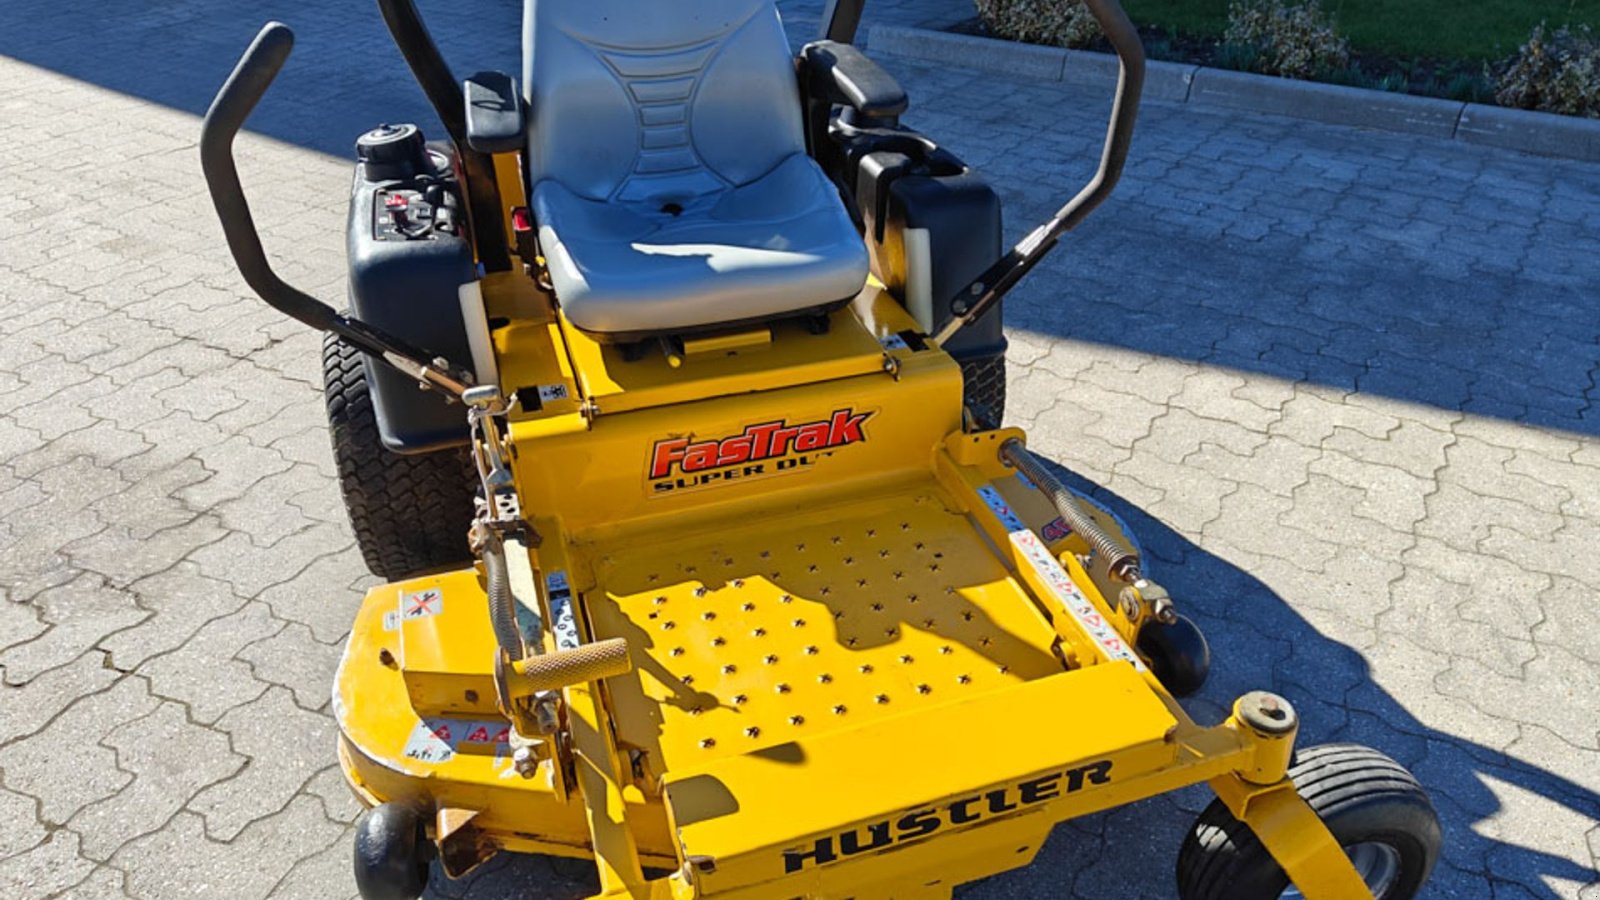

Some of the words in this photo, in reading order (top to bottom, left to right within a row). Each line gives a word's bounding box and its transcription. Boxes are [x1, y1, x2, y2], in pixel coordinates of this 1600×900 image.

[649, 408, 876, 480] FasTrak
[654, 464, 764, 493] SUPER
[782, 759, 1114, 874] HUSTLER
